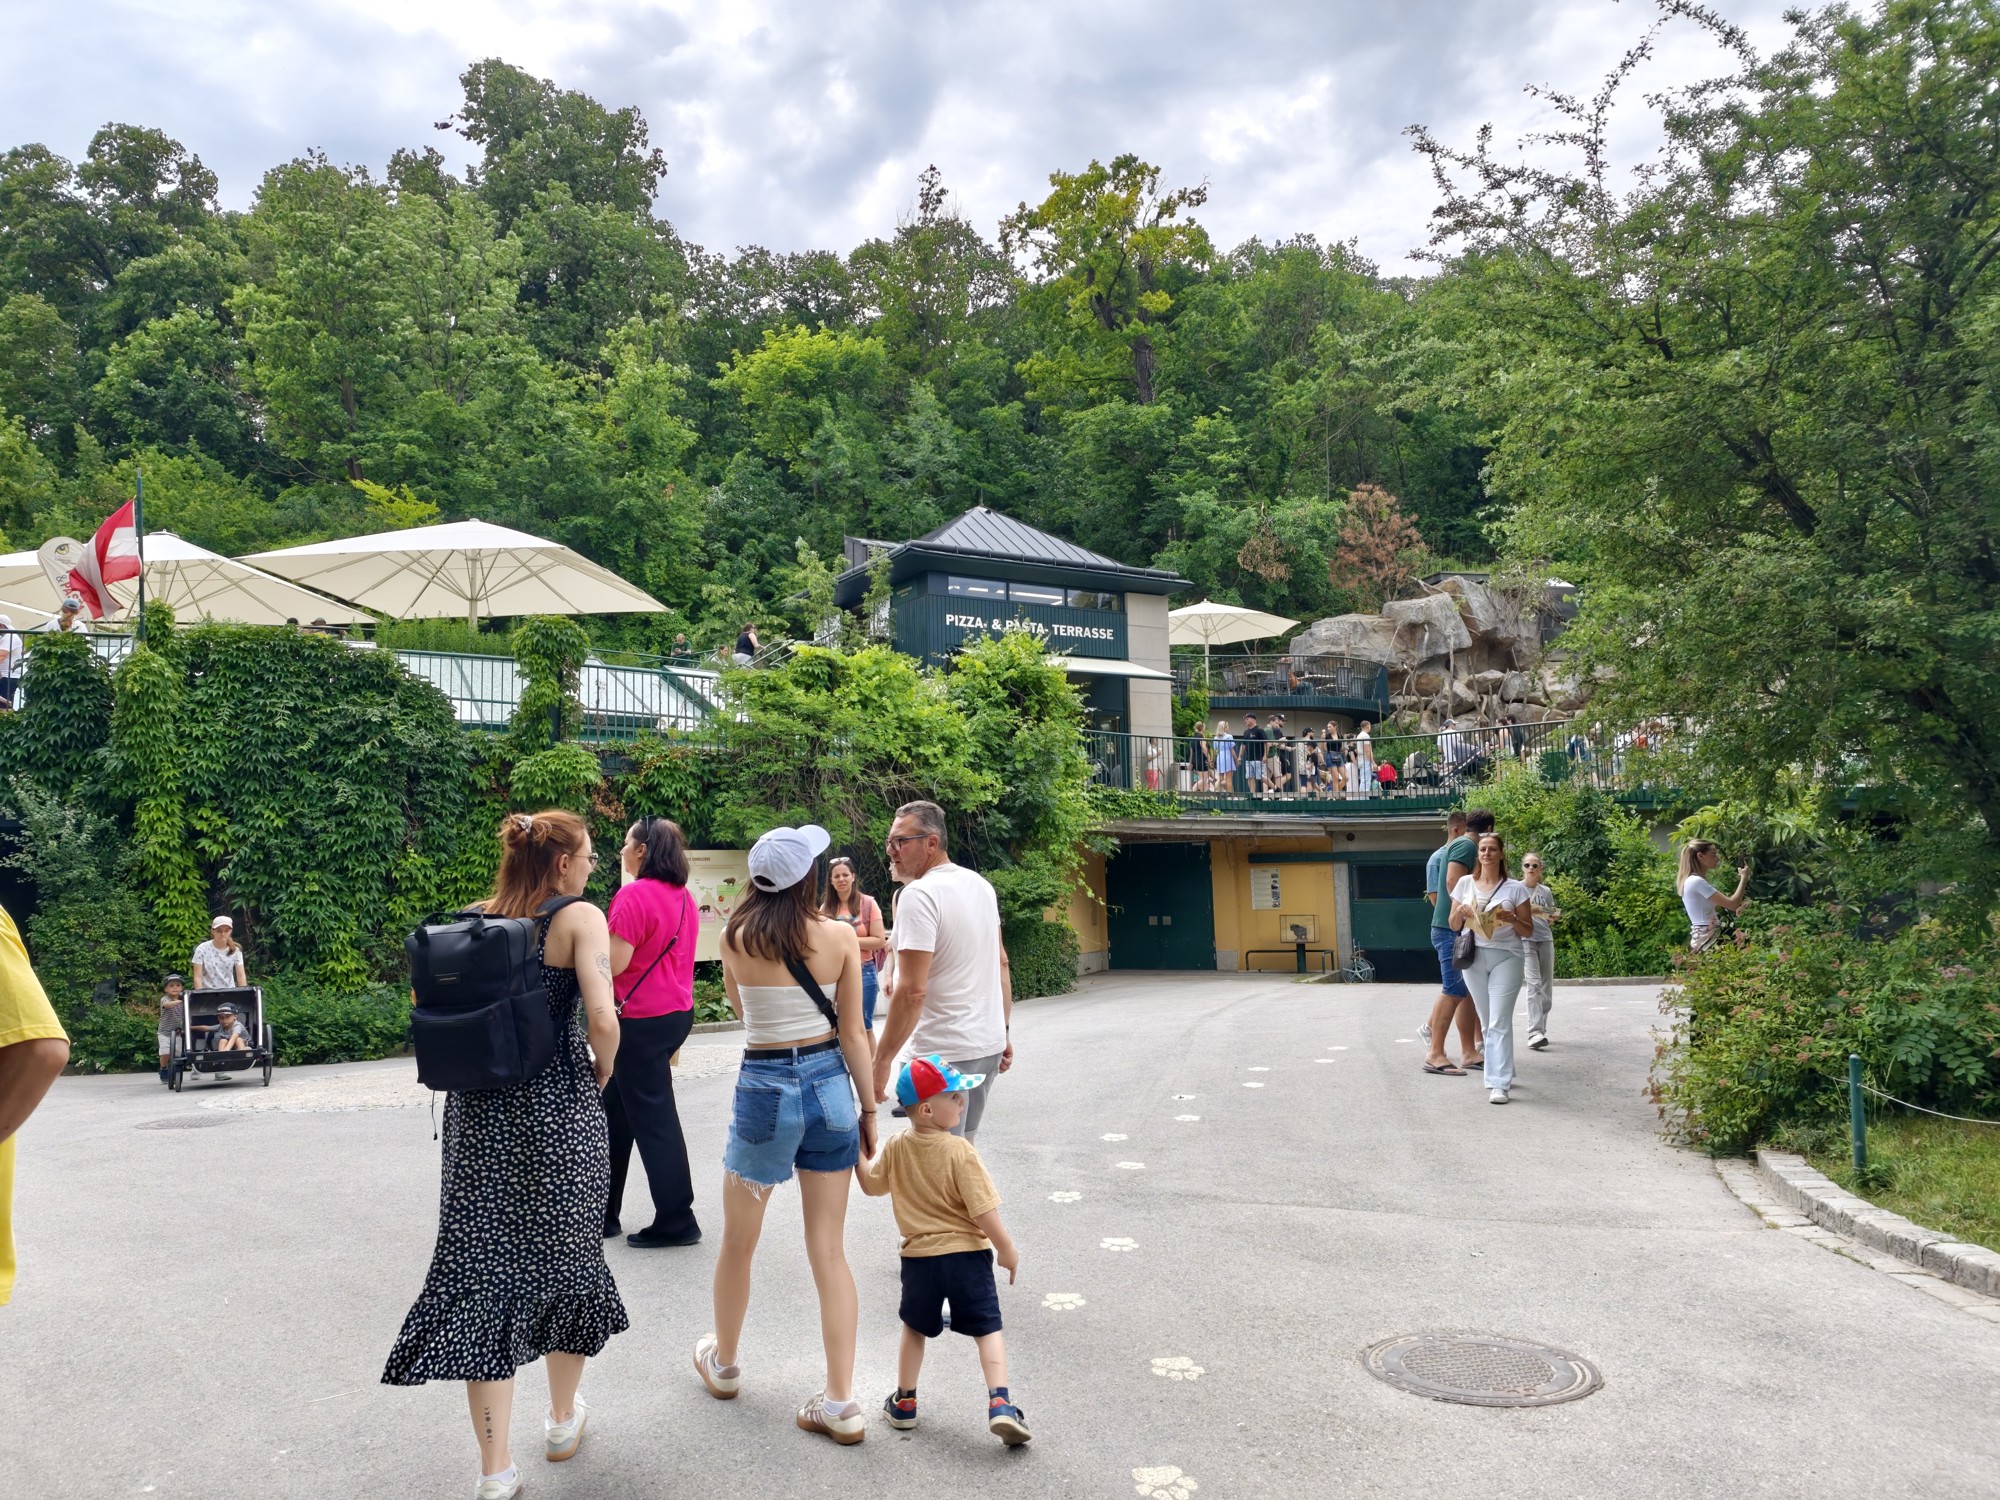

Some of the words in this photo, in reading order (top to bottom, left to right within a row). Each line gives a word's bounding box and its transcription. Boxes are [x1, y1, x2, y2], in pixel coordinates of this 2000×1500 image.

[946, 614, 987, 629] PIZZA-
[992, 618, 1001, 630] &
[1052, 624, 1114, 640] TERRASSE
